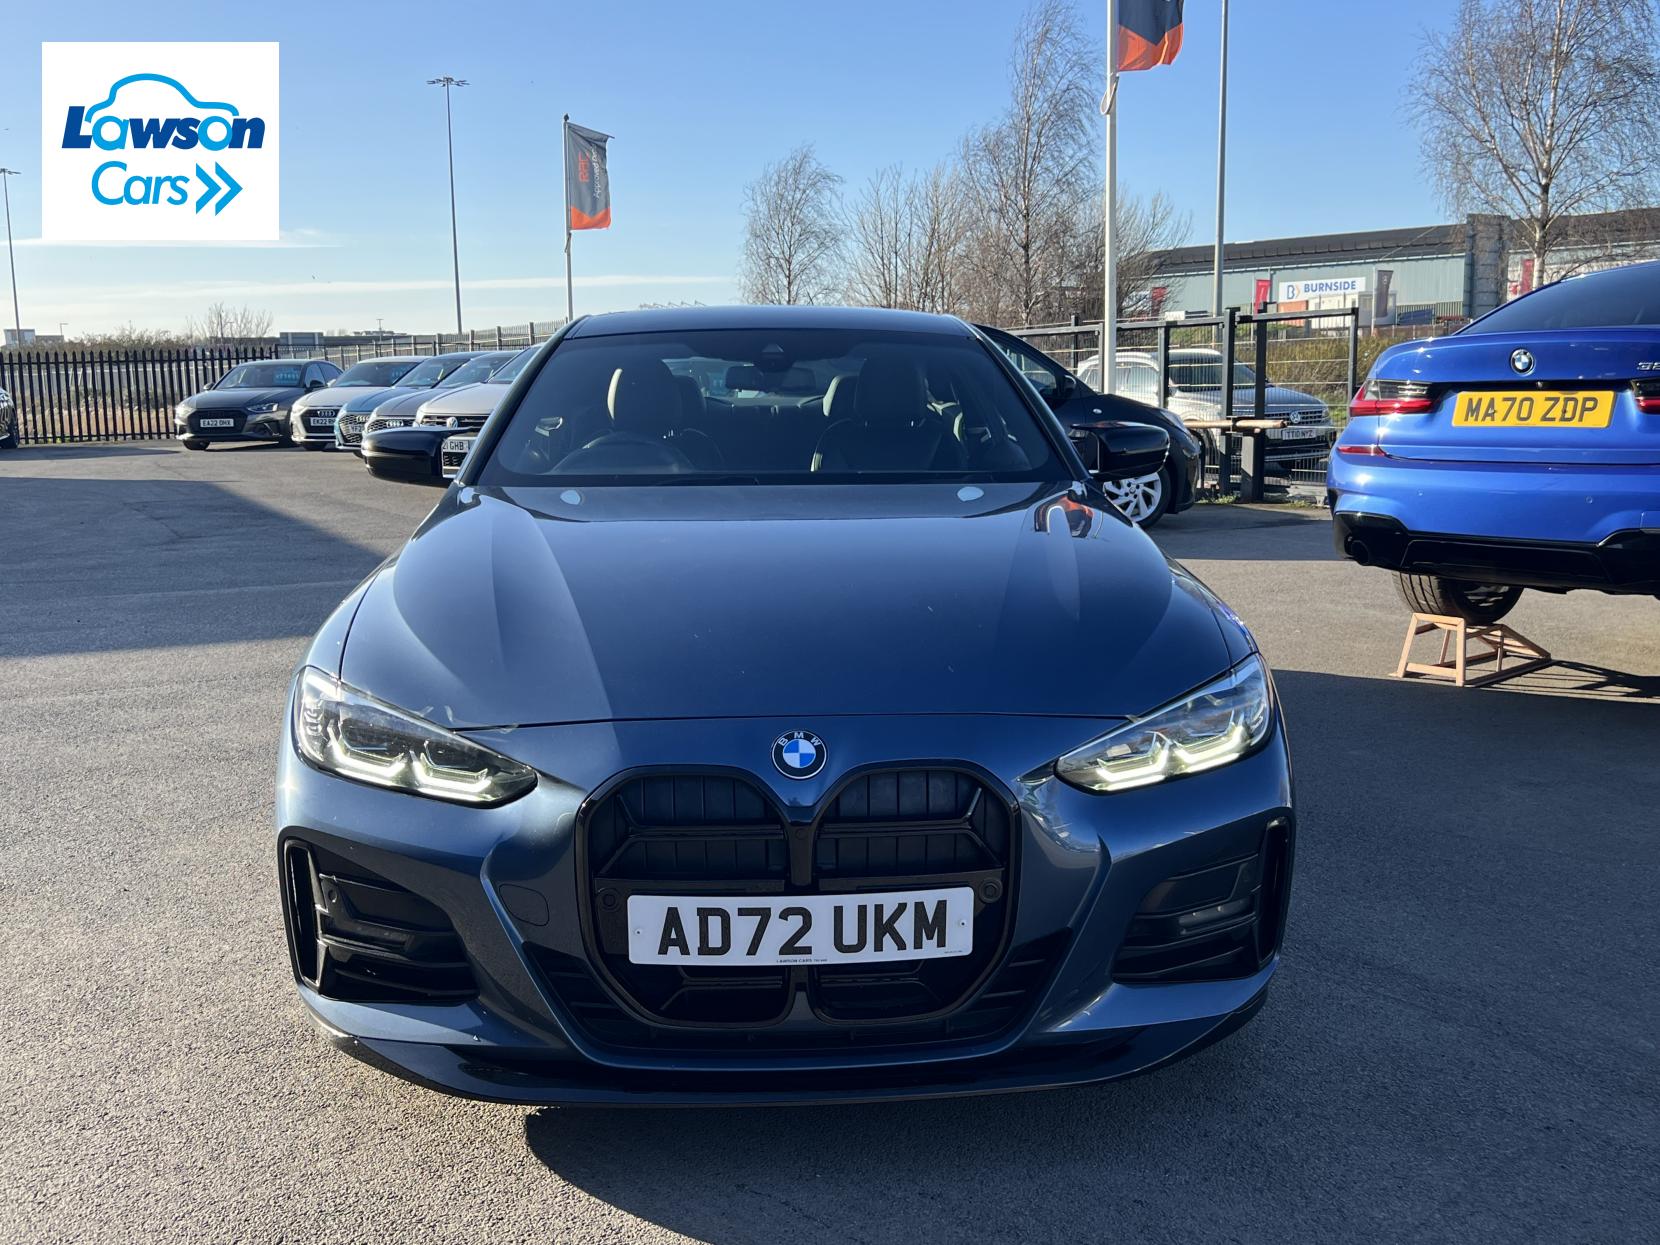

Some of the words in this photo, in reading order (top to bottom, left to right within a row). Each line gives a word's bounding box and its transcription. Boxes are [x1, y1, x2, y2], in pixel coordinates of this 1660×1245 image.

[1304, 280, 1356, 293] BURNSIDE
[1463, 396, 1535, 422] MA70
[1540, 396, 1599, 423] ZDP
[449, 441, 464, 451] GHB
[778, 731, 821, 746] BMW
[657, 906, 813, 957] AD72
[833, 899, 948, 955] UKM
